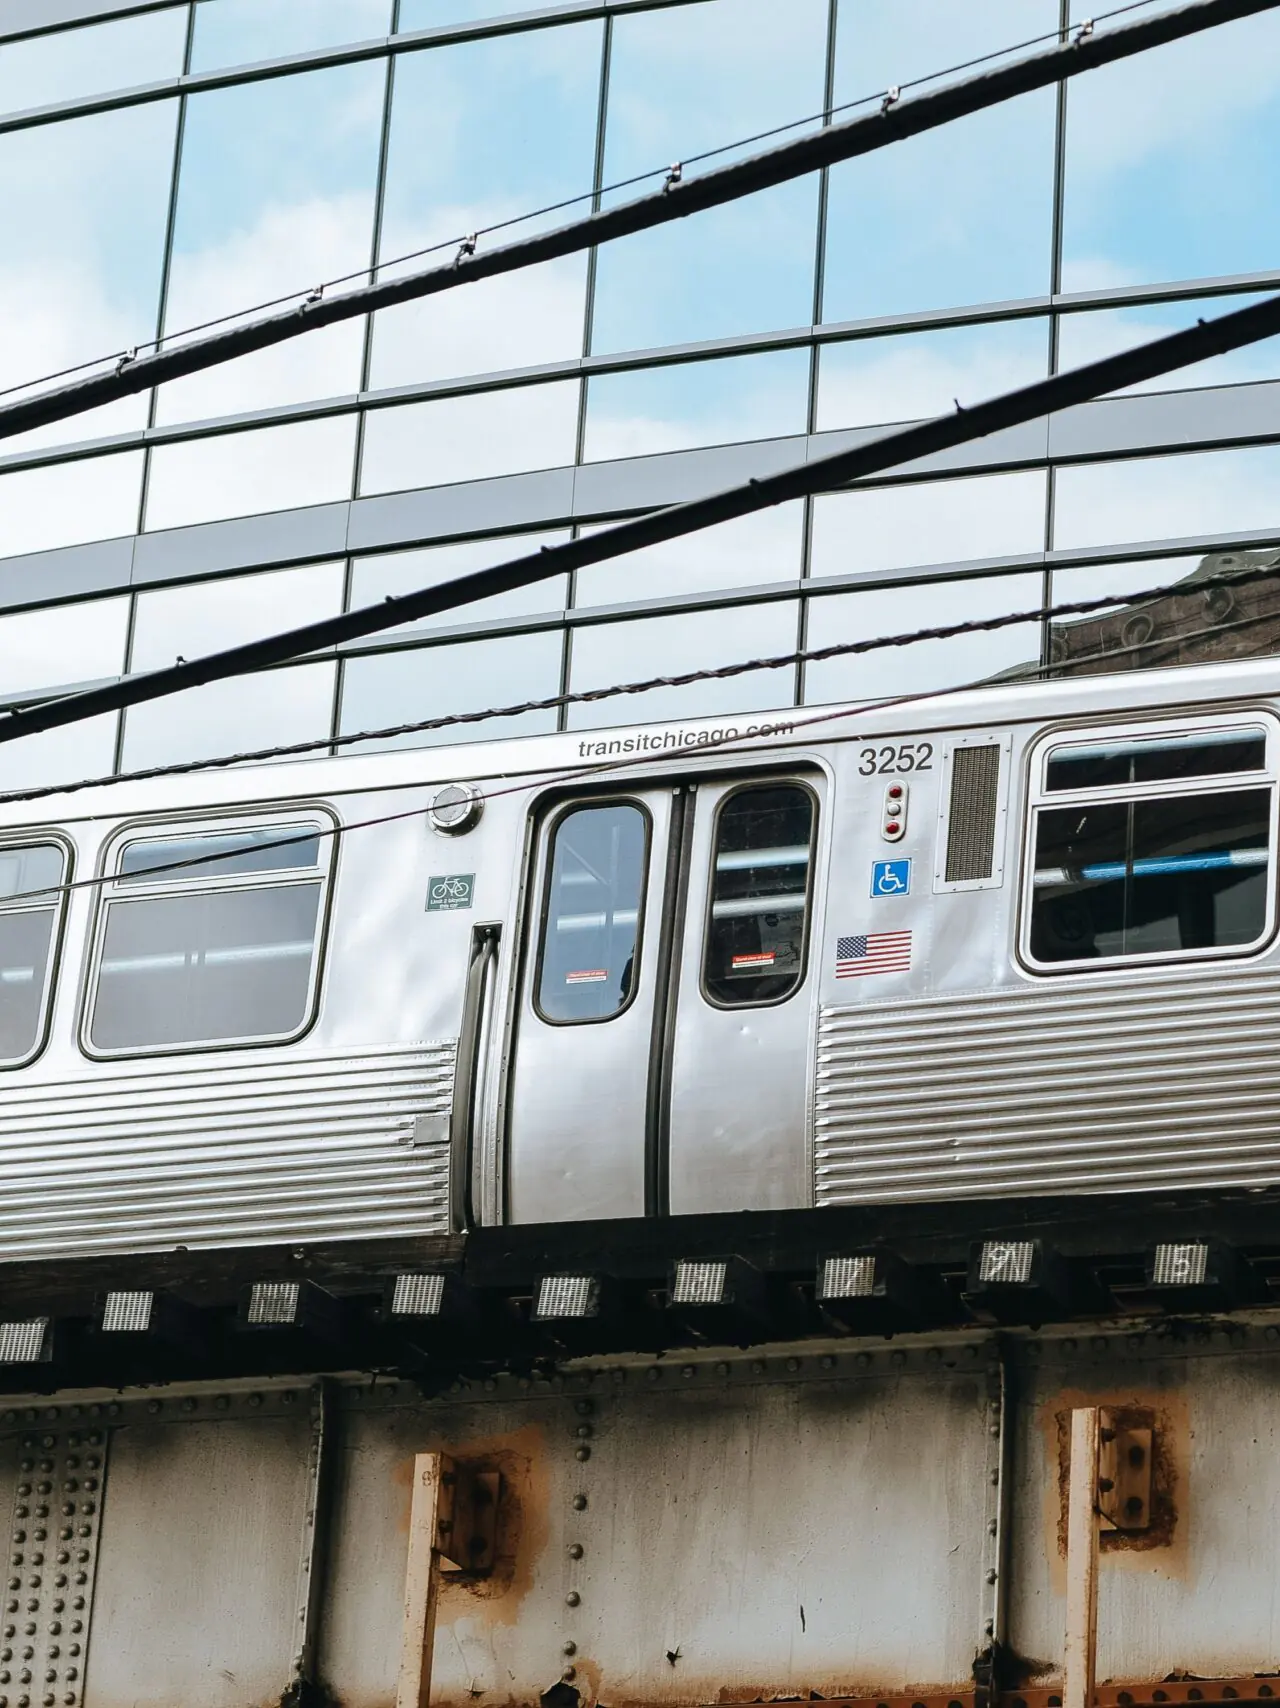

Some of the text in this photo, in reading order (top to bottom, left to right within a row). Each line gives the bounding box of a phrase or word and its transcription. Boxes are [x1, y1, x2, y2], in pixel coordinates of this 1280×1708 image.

[578, 720, 795, 758] transitchicagocom
[858, 742, 934, 777] 3252
[1173, 1244, 1196, 1277] 5
